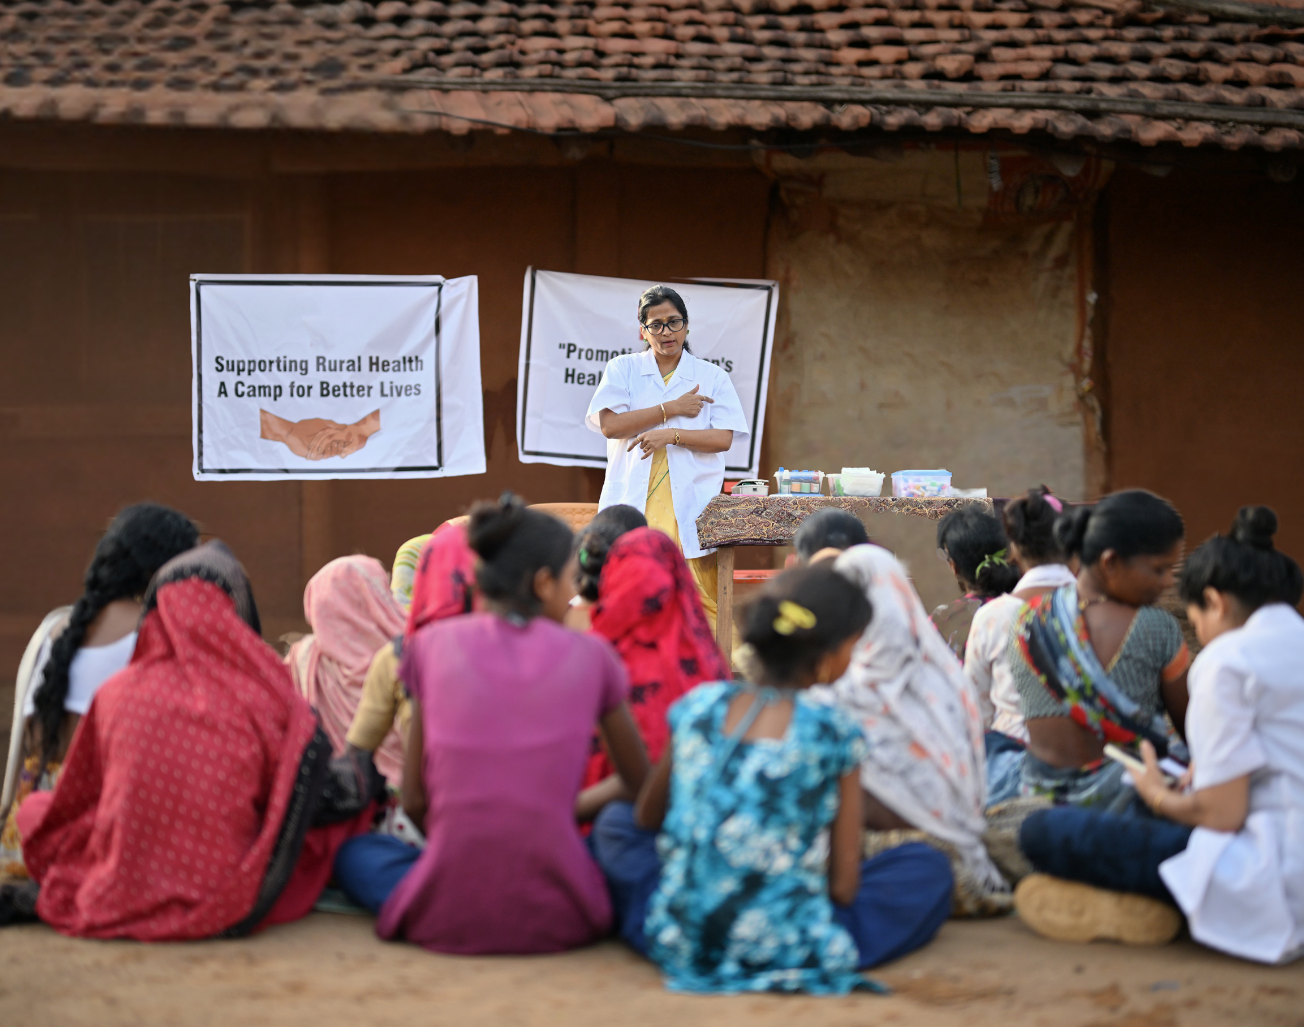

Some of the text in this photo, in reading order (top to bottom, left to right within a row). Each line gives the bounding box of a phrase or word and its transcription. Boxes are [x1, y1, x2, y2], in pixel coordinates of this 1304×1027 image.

[214, 355, 424, 376] Supporting Rural Health
[217, 380, 422, 401] A Camp for Better Lives
